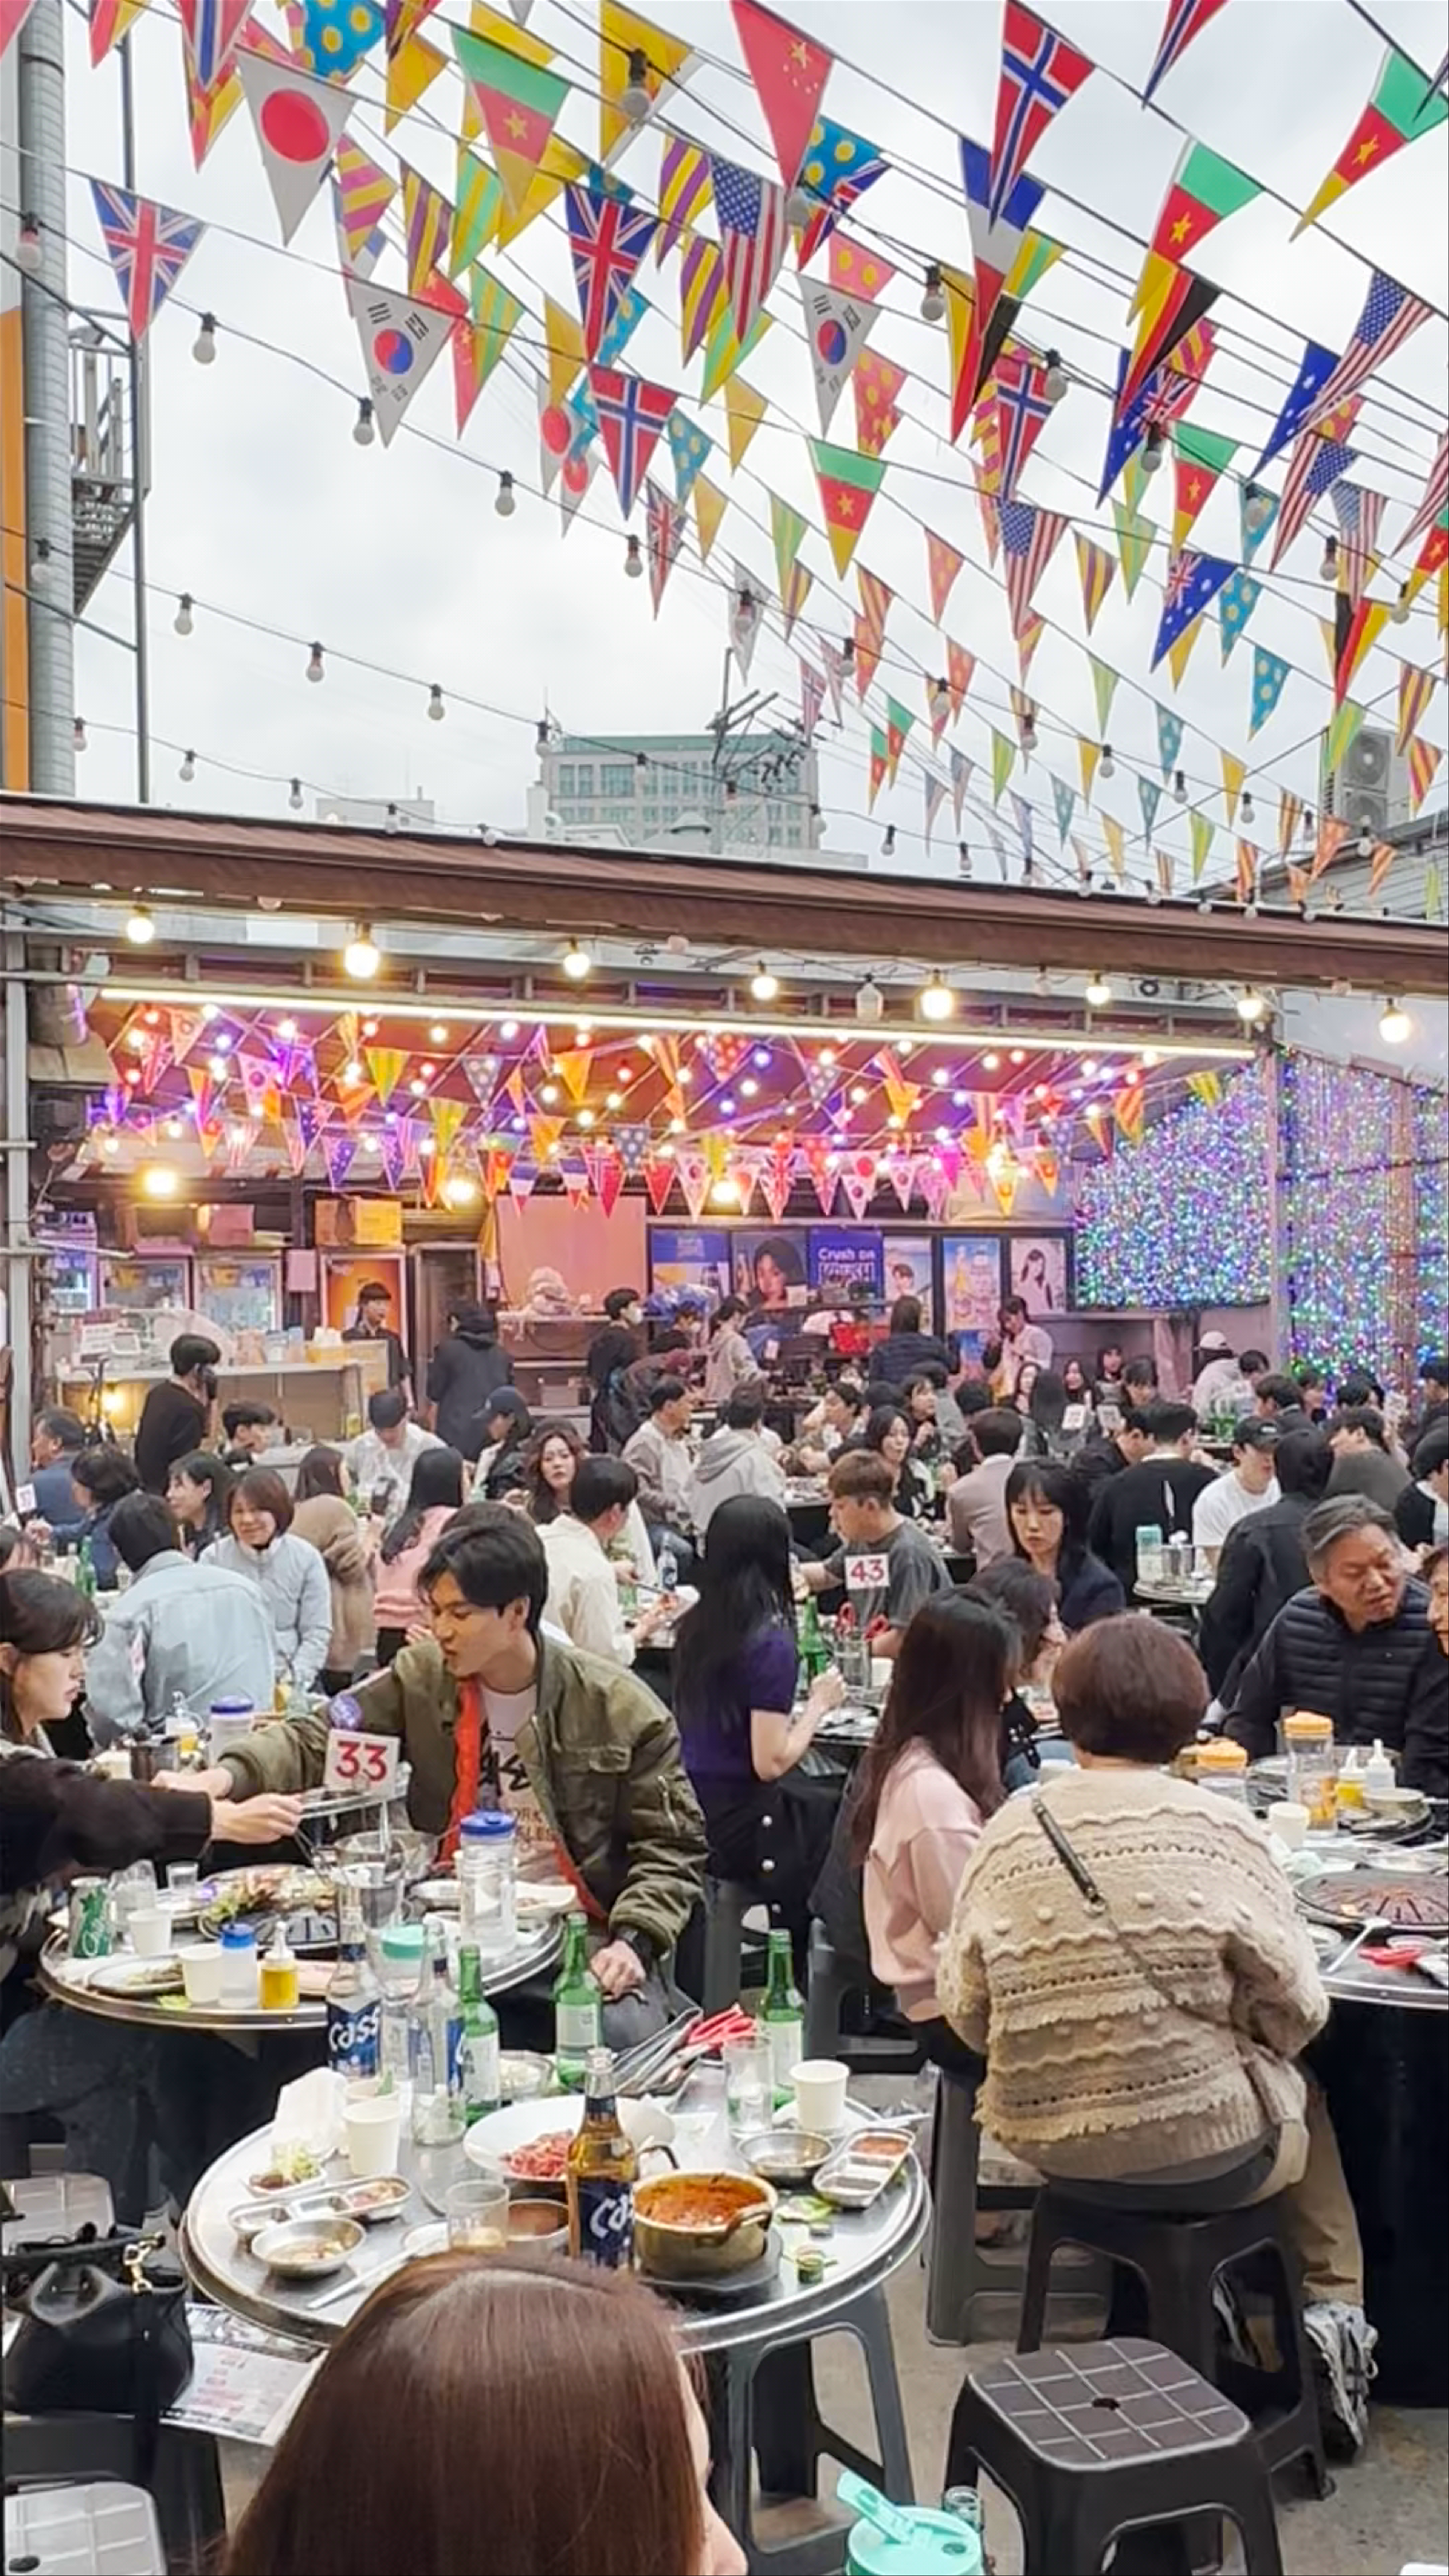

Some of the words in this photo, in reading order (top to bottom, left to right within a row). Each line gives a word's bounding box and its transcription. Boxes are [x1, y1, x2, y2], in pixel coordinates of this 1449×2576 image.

[818, 1247, 855, 1261] Crush
[858, 1250, 876, 1261] on
[851, 1558, 884, 1582] 43
[335, 1740, 388, 1782] 33
